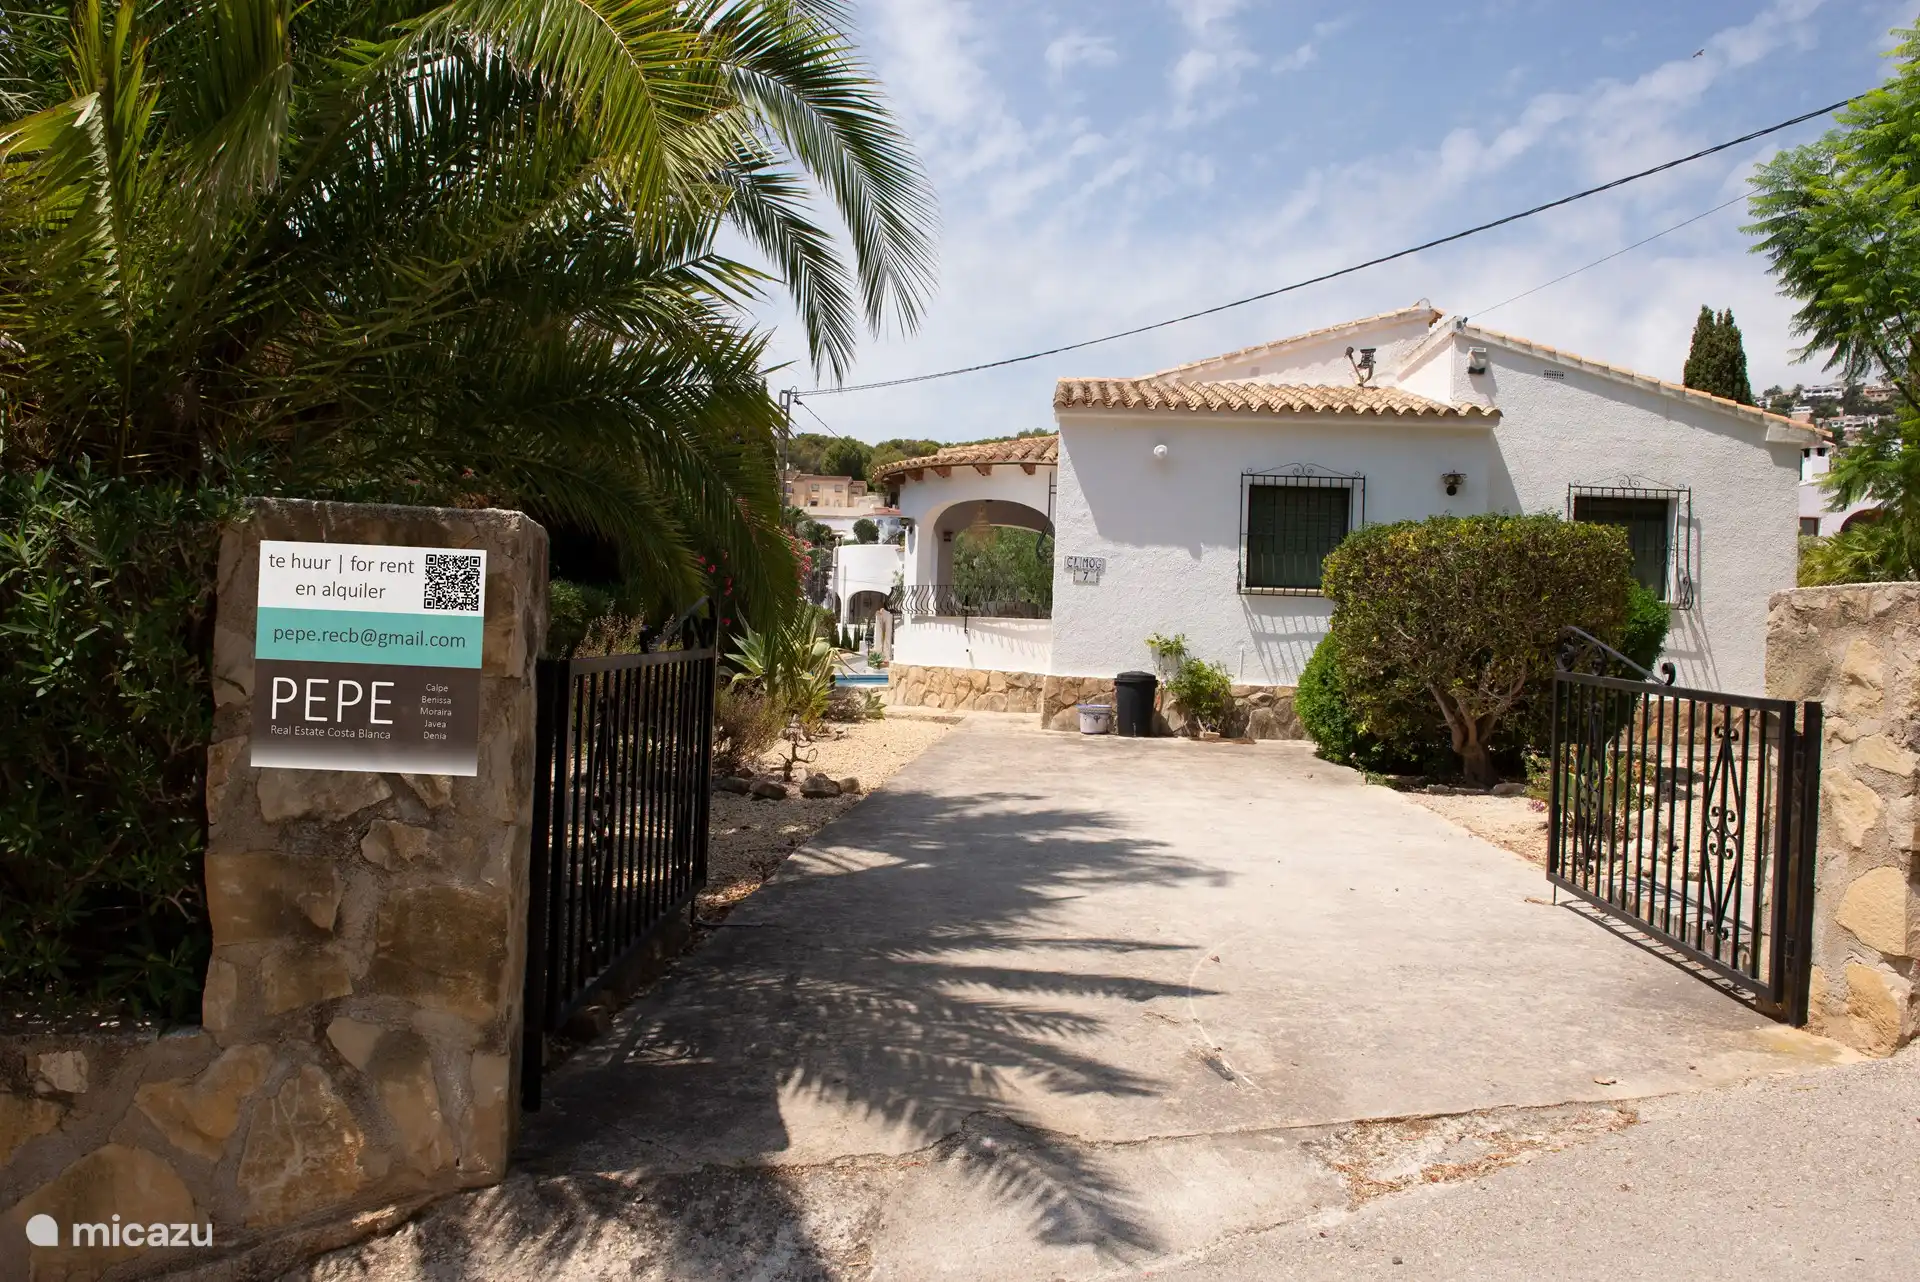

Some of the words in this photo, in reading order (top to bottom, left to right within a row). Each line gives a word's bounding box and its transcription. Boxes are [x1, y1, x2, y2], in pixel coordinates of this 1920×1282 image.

[268, 553, 286, 568] te
[291, 552, 332, 570] huur
[350, 555, 375, 572] for
[379, 559, 415, 574] rent
[295, 583, 316, 597] en
[321, 580, 387, 601] alquiler
[272, 626, 467, 649] pepe.recb@gmail.com
[425, 683, 449, 694] Calpe
[271, 676, 395, 725] PEPE
[421, 695, 452, 705] Benissa
[420, 707, 452, 717] Moraira
[424, 719, 447, 729] Javea
[270, 724, 292, 736] Real
[294, 725, 325, 737] Estate
[327, 727, 356, 739] Costa
[358, 728, 391, 740] Blanca
[423, 731, 447, 740] Denia
